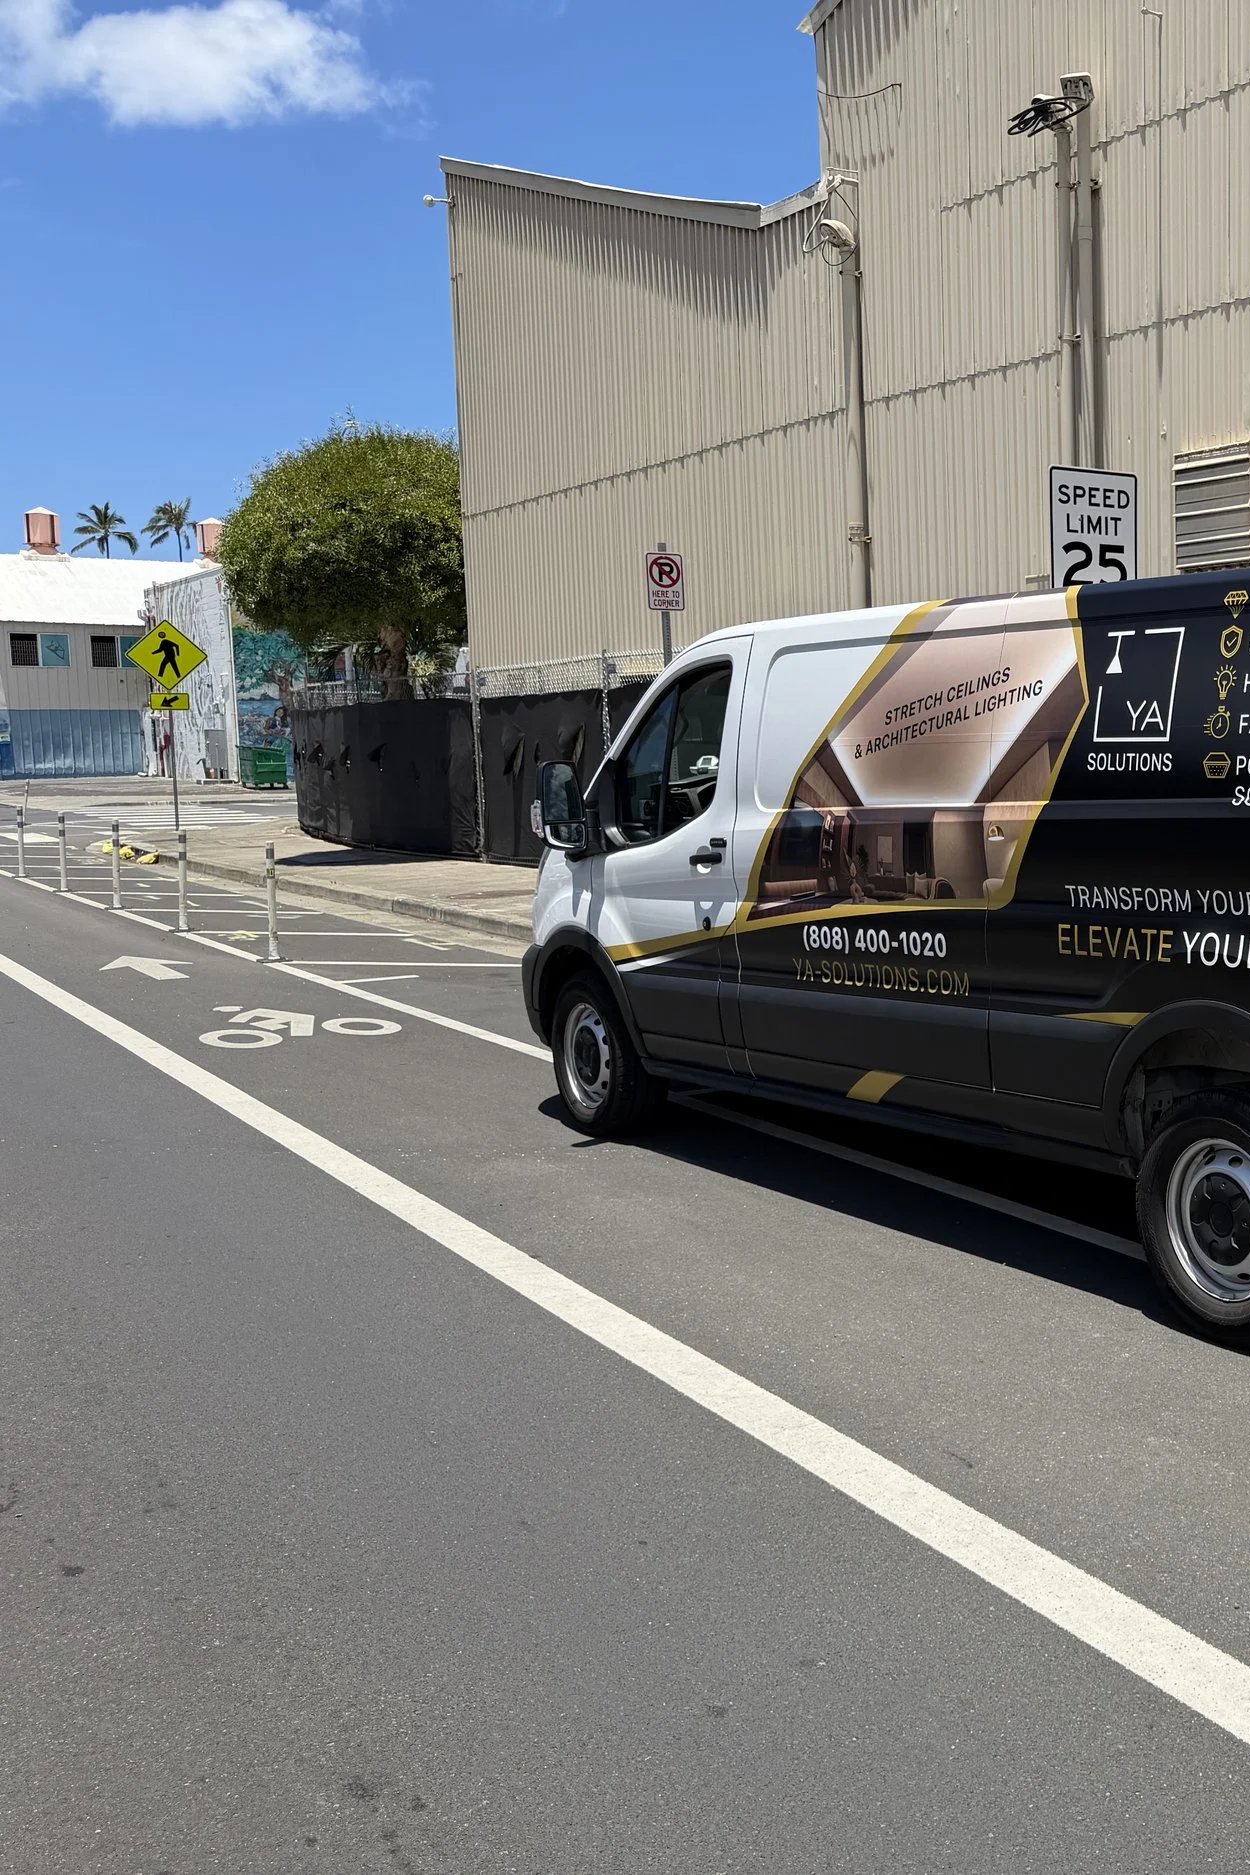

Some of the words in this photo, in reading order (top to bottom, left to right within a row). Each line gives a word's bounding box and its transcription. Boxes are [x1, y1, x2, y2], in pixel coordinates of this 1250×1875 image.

[1058, 484, 1130, 509] SPEED
[1066, 513, 1122, 536] LIMIT
[1062, 541, 1127, 587] 25
[652, 590, 669, 598] HERE
[672, 590, 680, 598] TO
[653, 599, 680, 608] CORNER
[884, 691, 944, 726] STRETCH
[946, 666, 1011, 703] CEILINGS
[854, 744, 863, 760] &
[865, 705, 970, 757] ARCHITECTURAL
[974, 679, 1044, 718] LIGHTING
[1126, 700, 1164, 732] YA
[1087, 753, 1172, 772] SOLUTIONS
[1064, 885, 1193, 913] TRANSFORM
[803, 925, 849, 954] (808)
[855, 928, 946, 958] 400-1020
[1058, 923, 1174, 963] ELEVATE
[793, 957, 970, 996] YA-SOLUTIONS.COM
